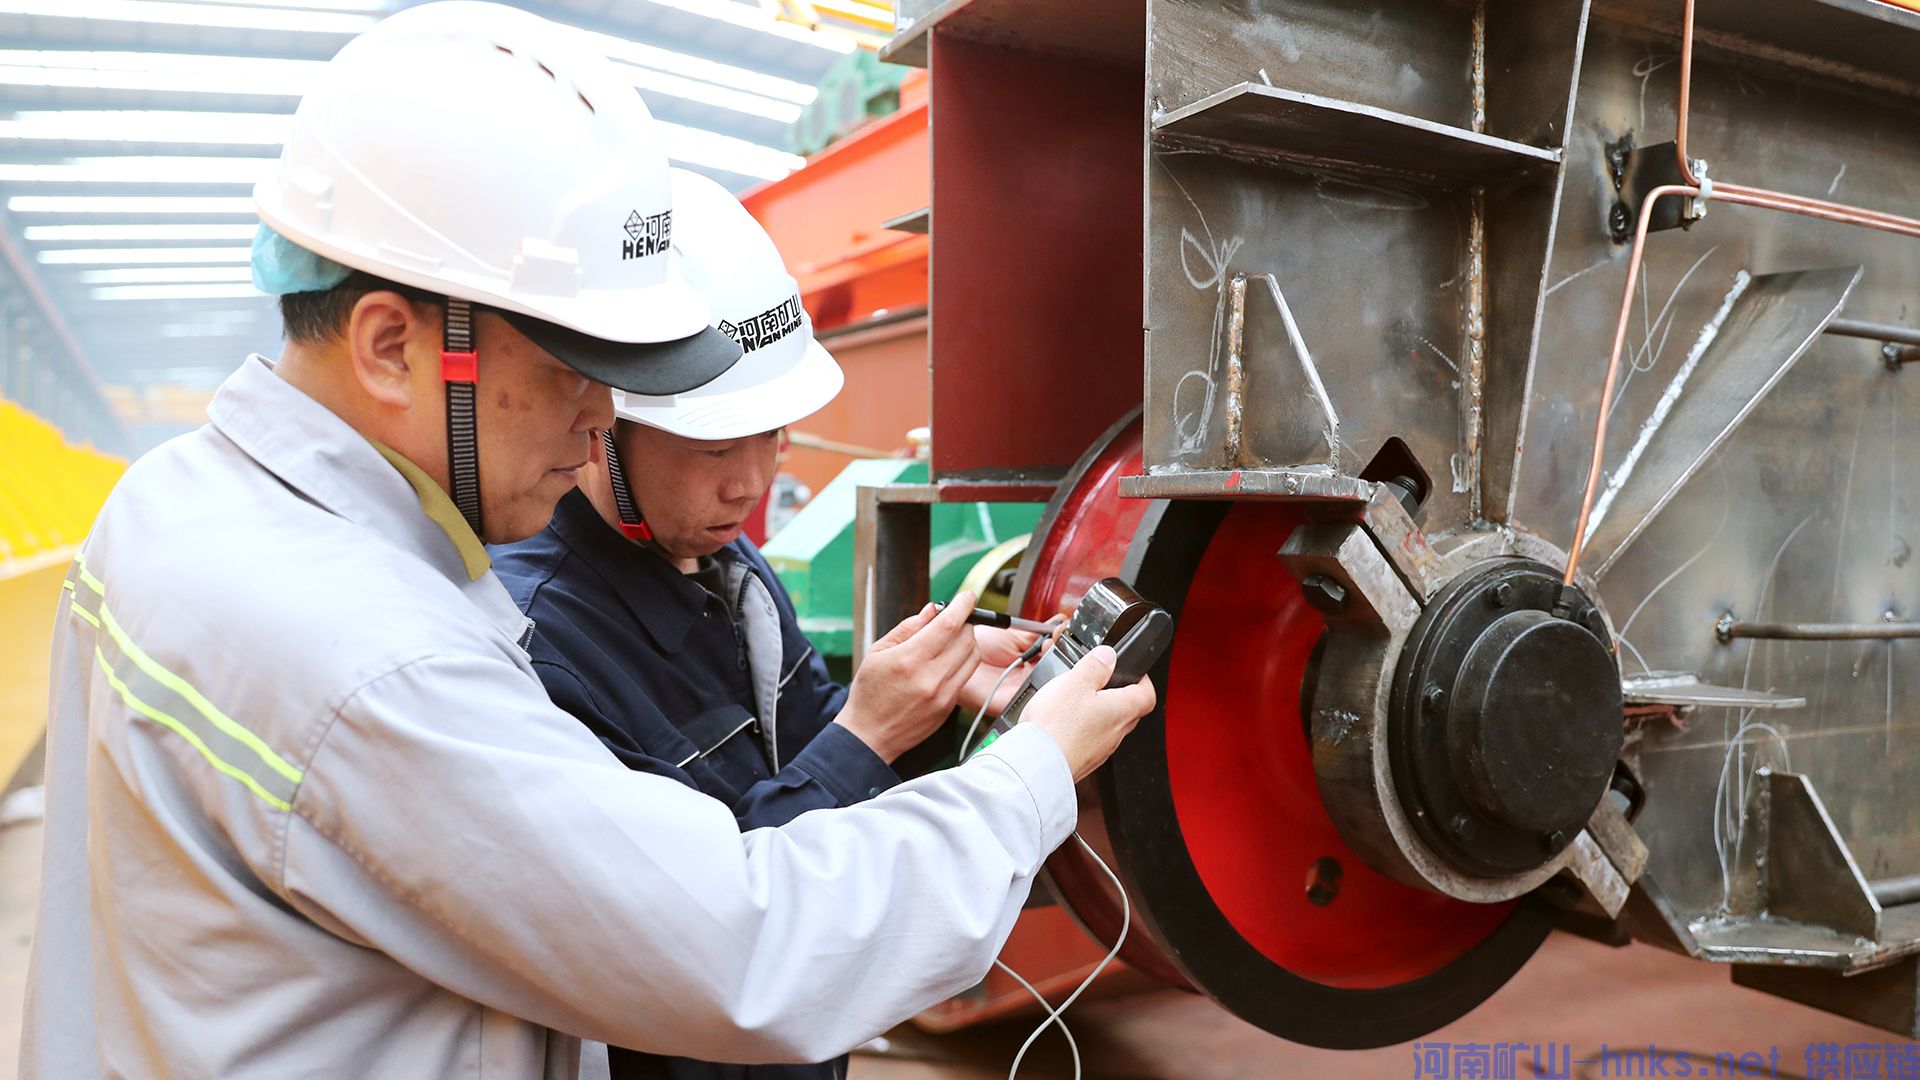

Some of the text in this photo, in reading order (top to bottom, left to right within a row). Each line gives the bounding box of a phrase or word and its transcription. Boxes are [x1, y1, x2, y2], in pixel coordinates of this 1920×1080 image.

[738, 293, 801, 342] 河南矿山
[735, 332, 781, 354] NAN
